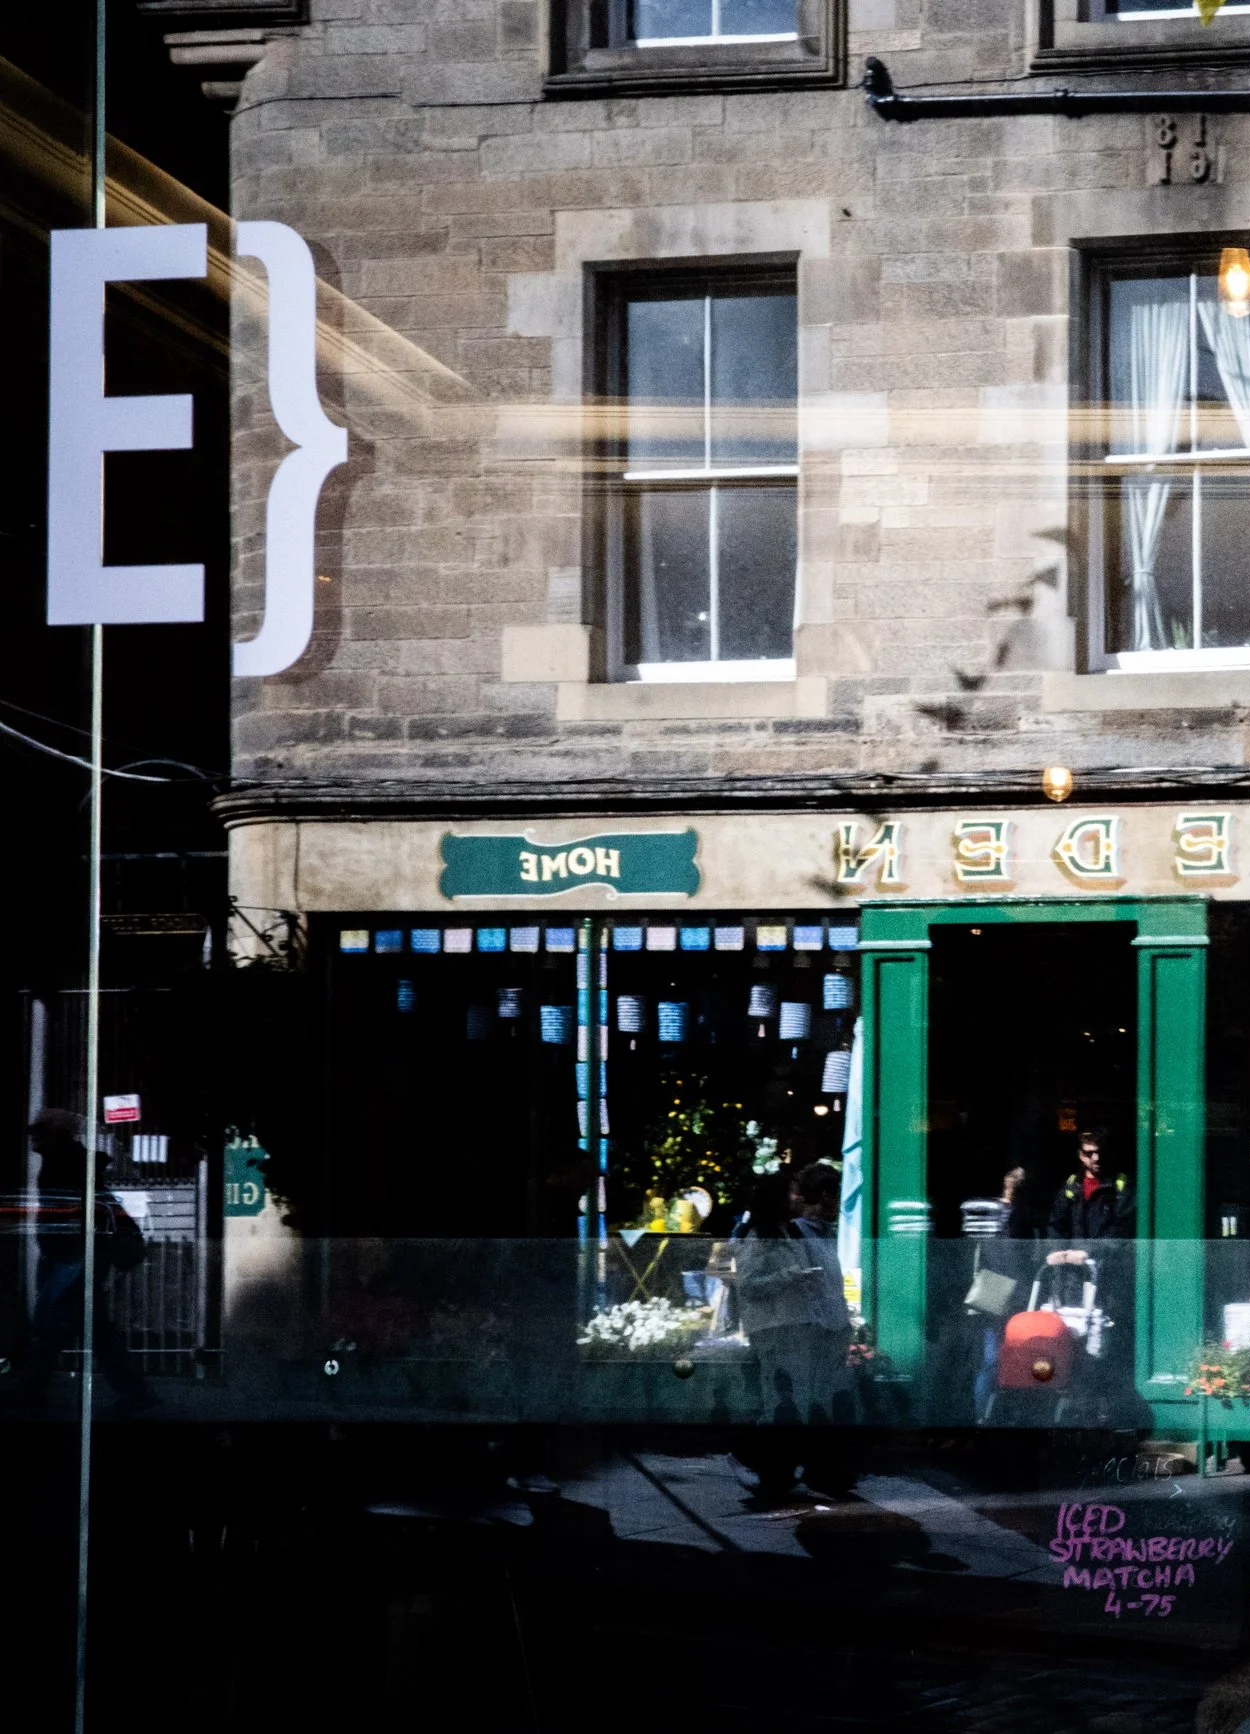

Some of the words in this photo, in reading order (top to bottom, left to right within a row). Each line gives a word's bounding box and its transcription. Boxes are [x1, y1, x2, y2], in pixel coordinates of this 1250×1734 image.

[1056, 1502, 1128, 1540] ICED
[1050, 1535, 1234, 1564] STRAWBERRY
[1063, 1563, 1196, 1590] MATCHA
[1103, 1588, 1177, 1618] 4-75
